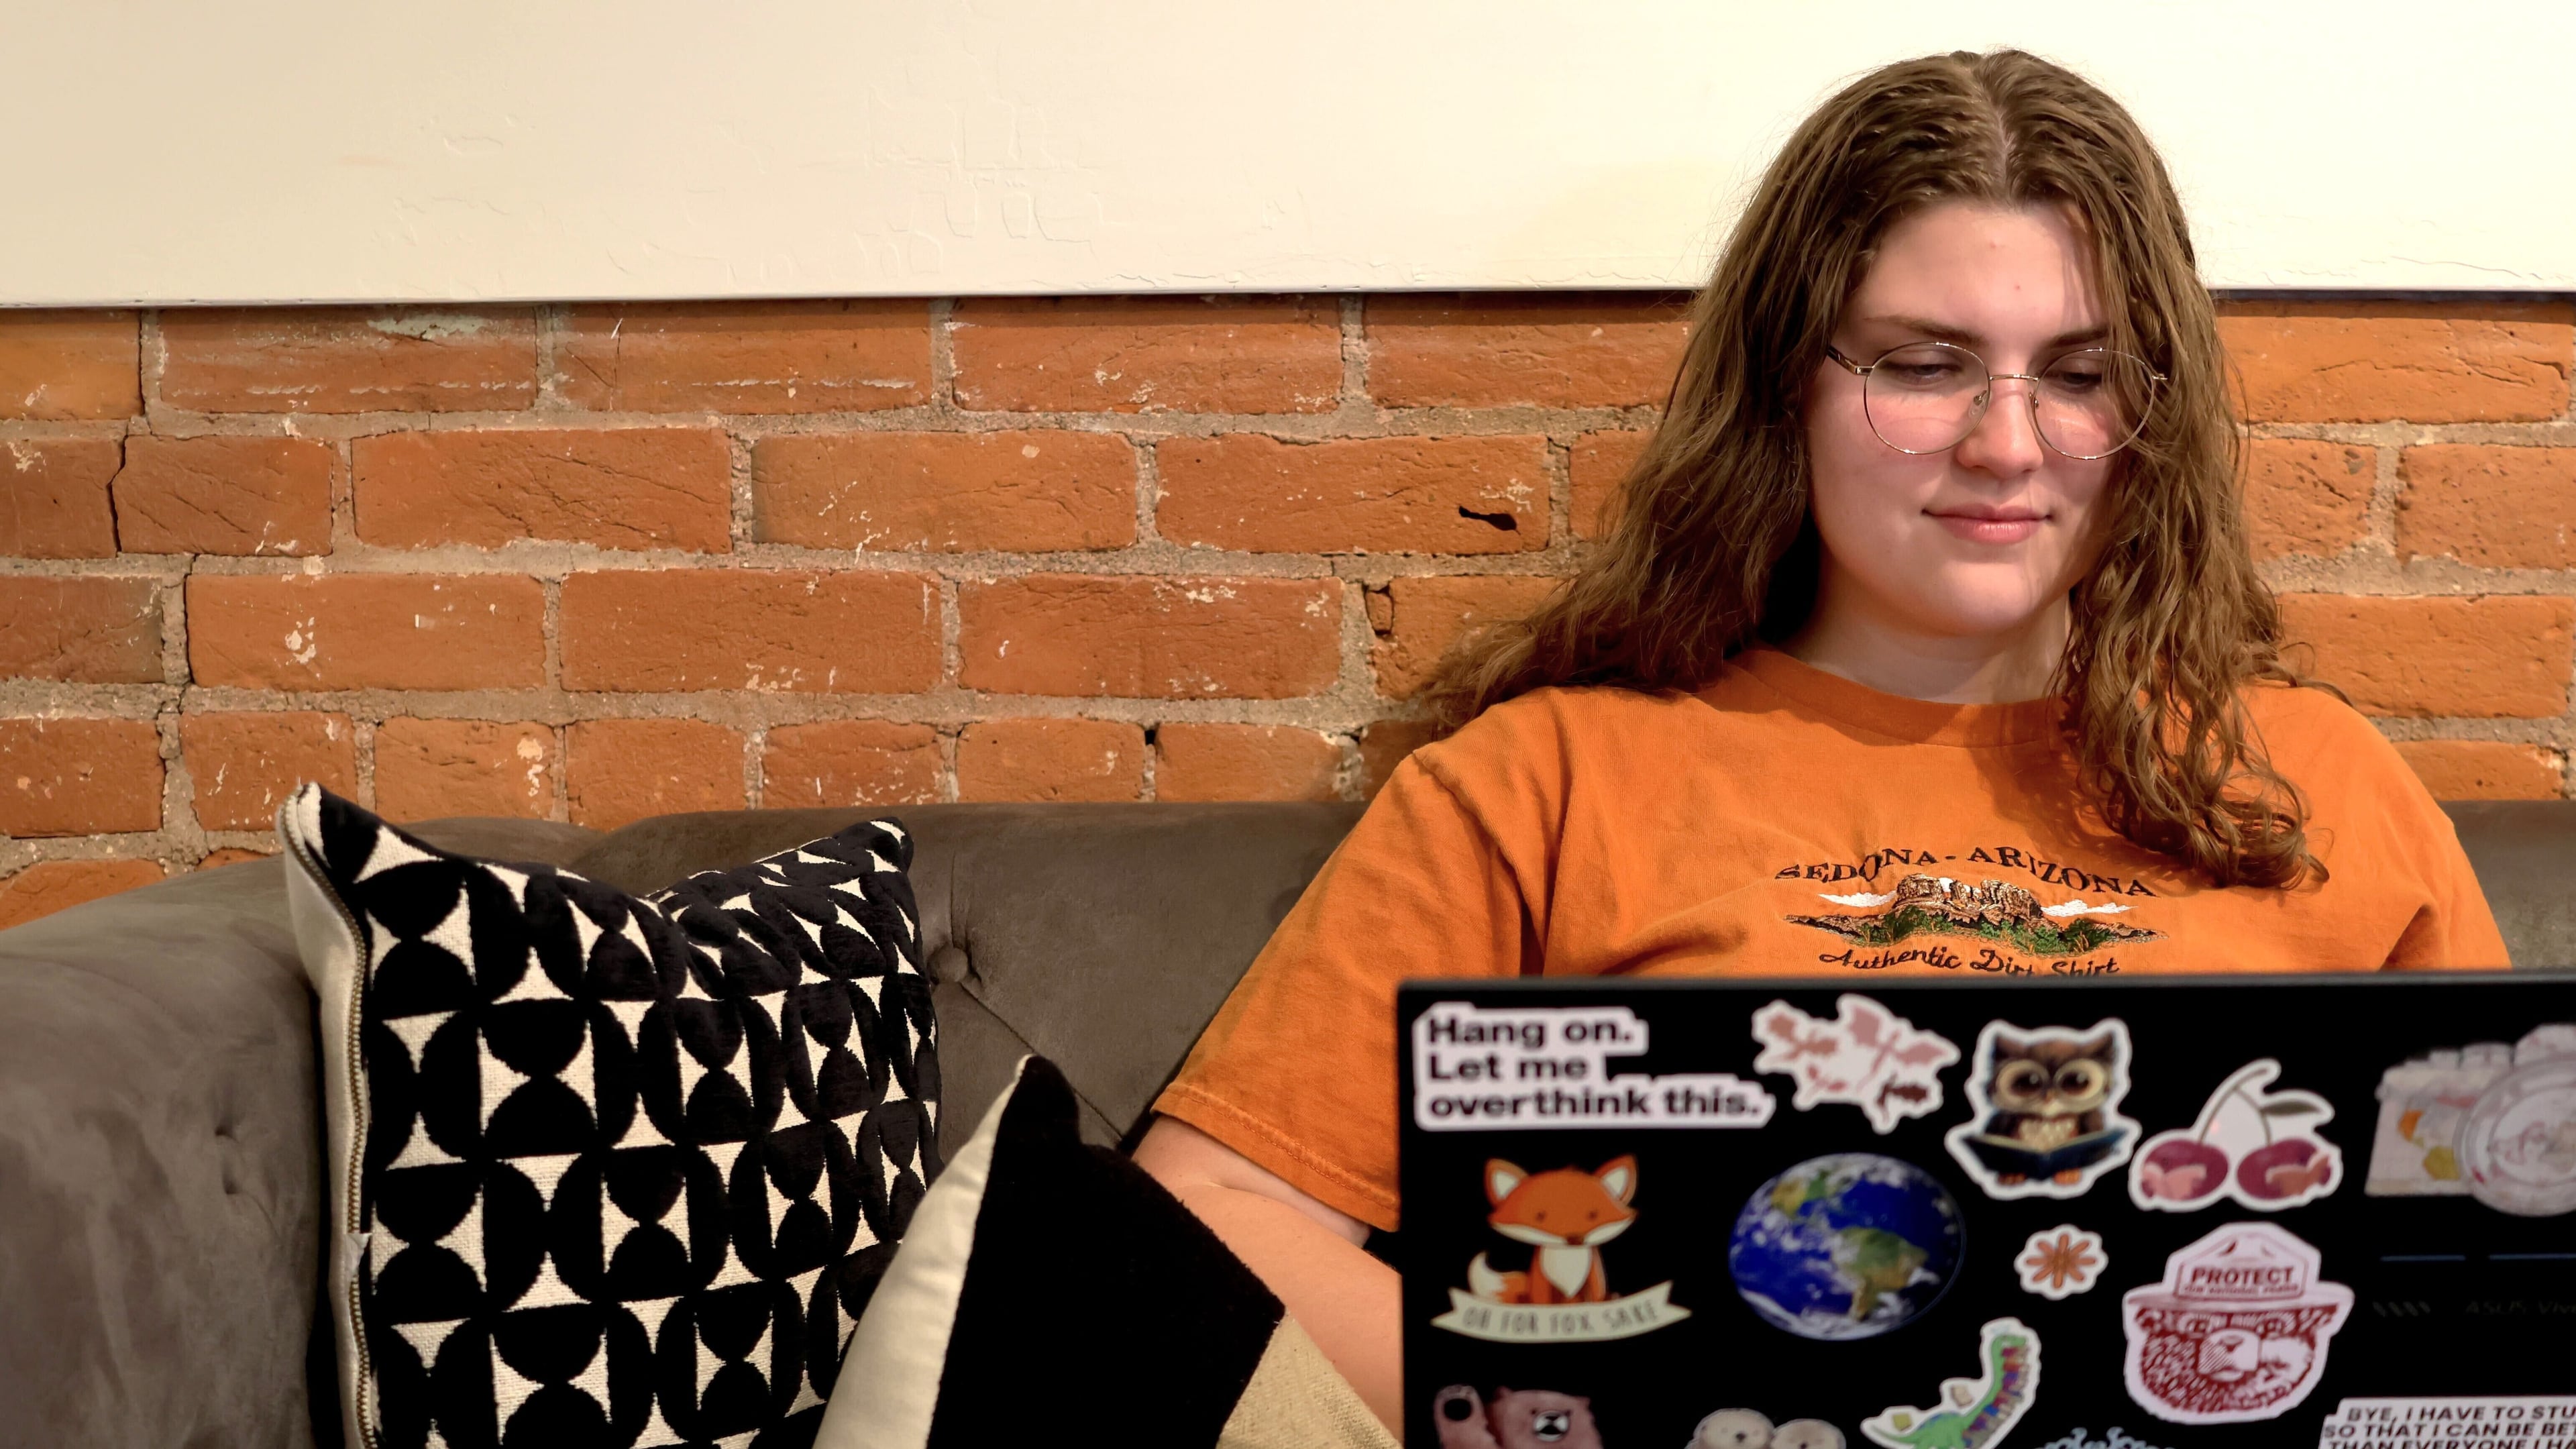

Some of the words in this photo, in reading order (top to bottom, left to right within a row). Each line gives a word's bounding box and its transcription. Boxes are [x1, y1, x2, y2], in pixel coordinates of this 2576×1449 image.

[1775, 848, 1938, 882] SEDONA
[1967, 845, 2157, 897] ARIZONA
[1819, 947, 1962, 969] Authentic
[1429, 1017, 1546, 1048] Hang
[1564, 1022, 1632, 1042] on.
[1430, 1055, 1500, 1080] Let
[1518, 1059, 1587, 1079] me
[1430, 1087, 1649, 1116] overthink
[1662, 1085, 1760, 1115] this.
[2192, 1265, 2294, 1285] PROTECT
[1500, 1311, 1540, 1334] FOR
[1550, 1312, 1594, 1334] FOX
[1602, 1299, 1658, 1330] SAKE
[2348, 1407, 2397, 1424] BYE,
[2406, 1407, 2414, 1421] I
[2419, 1407, 2485, 1421] HAVE
[2494, 1405, 2524, 1420] TO
[2324, 1424, 2355, 1438] SO
[2365, 1424, 2427, 1438] THAT
[2432, 1424, 2440, 1437] I
[2447, 1423, 2500, 1437] CAN
[2506, 1422, 2534, 1436] BE
[2330, 1440, 2394, 1449] THAN
[2401, 1439, 2527, 1449] EVERYONE
